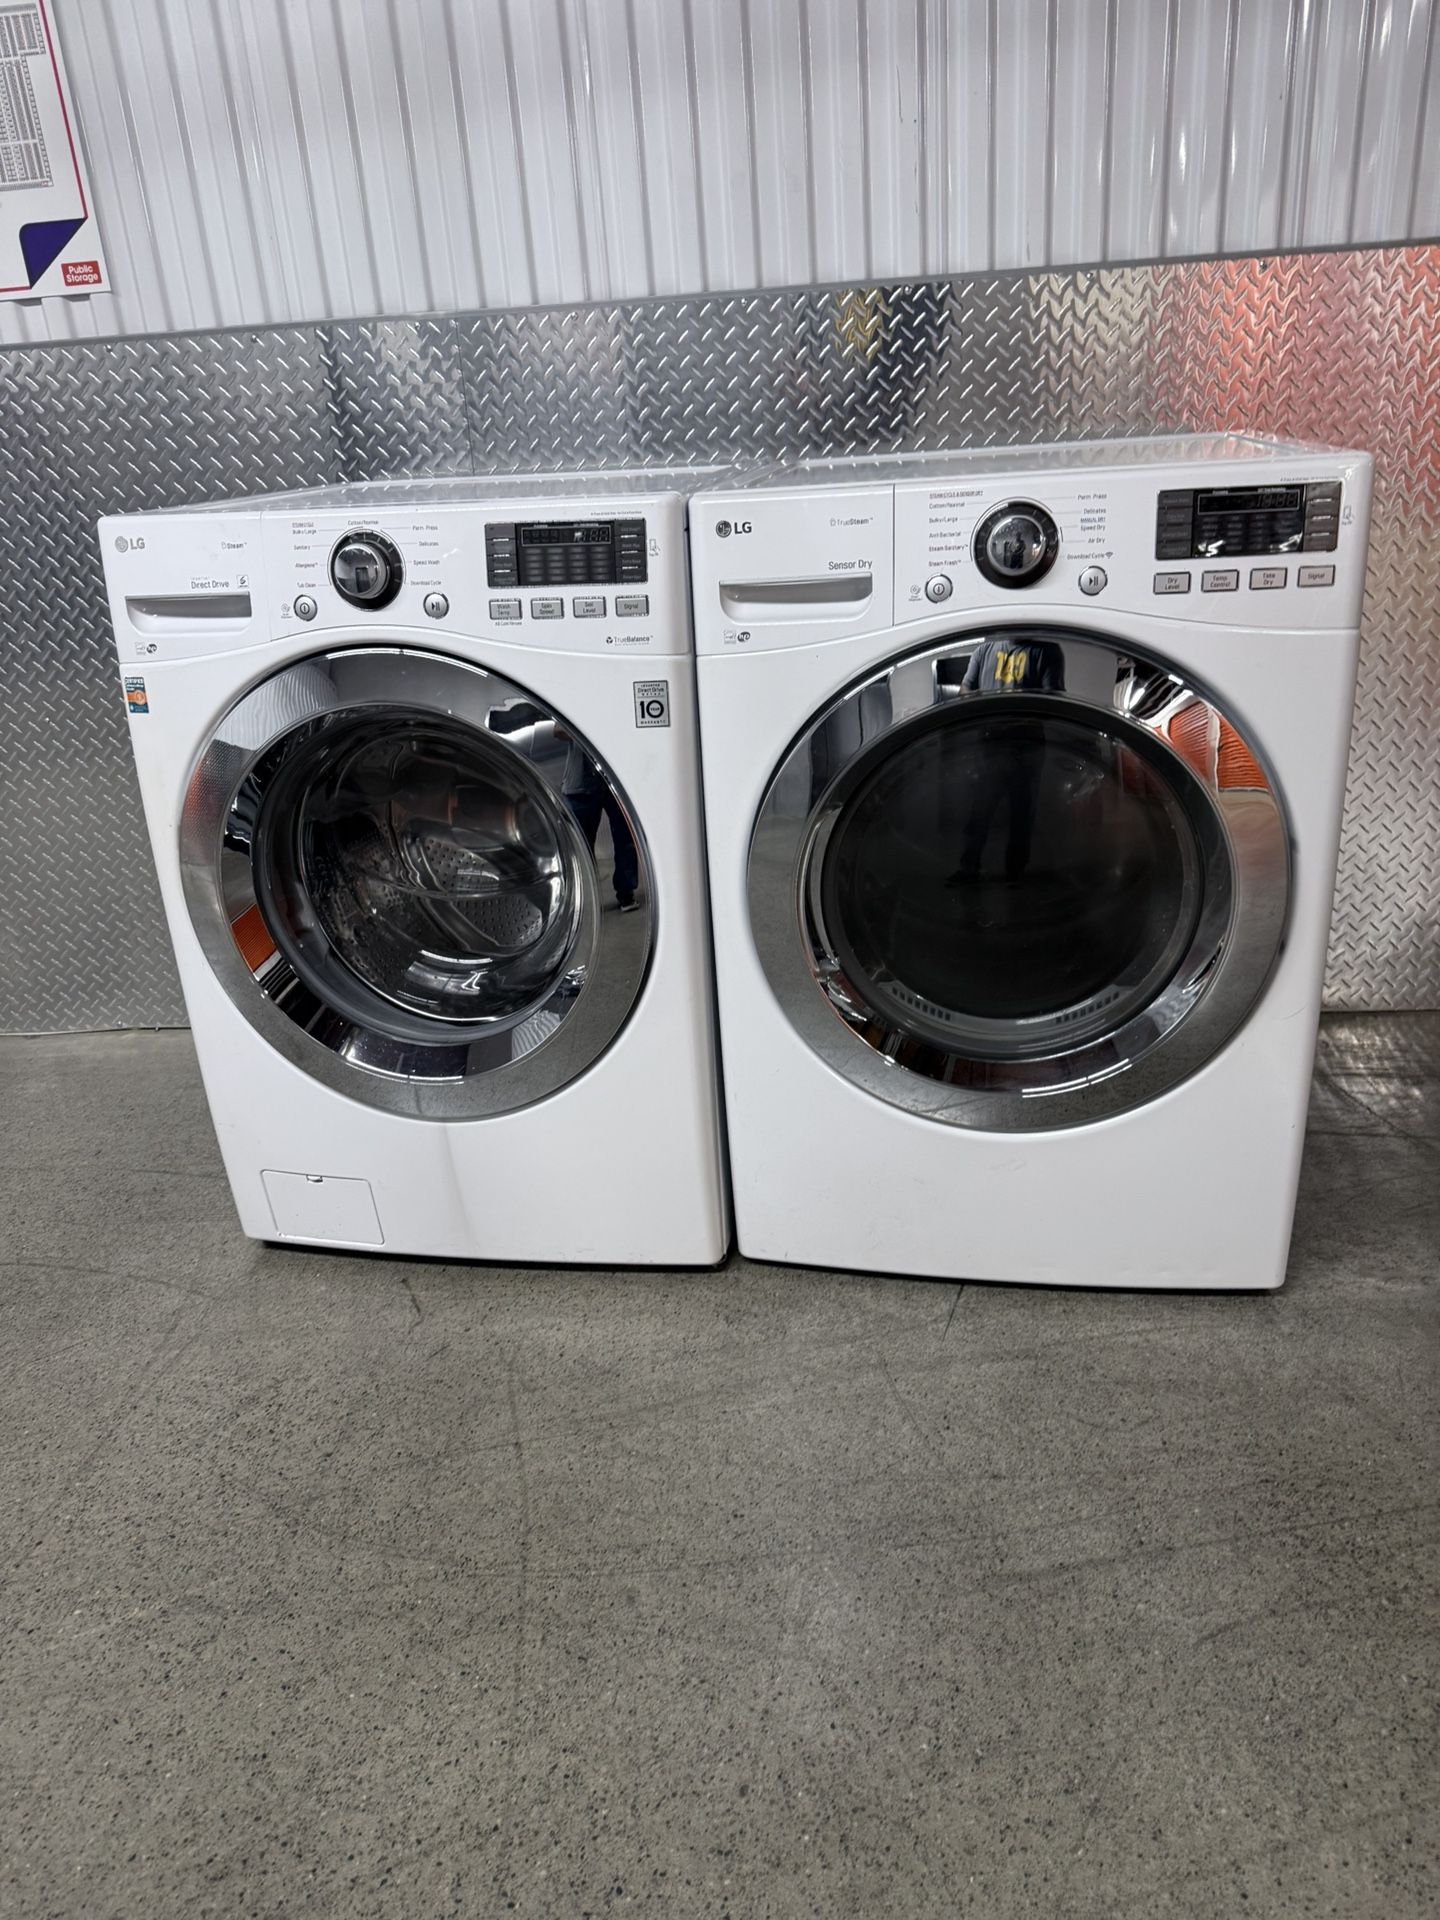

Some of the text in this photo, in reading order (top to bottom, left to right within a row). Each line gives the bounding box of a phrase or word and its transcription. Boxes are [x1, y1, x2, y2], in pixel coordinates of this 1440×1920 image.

[68, 264, 93, 275] Public
[66, 273, 99, 283] Storage
[734, 522, 753, 534] LG
[130, 537, 145, 550] LG
[828, 559, 873, 571] Sensor Dry
[191, 580, 230, 590] Direct Drive
[640, 700, 664, 719] 10
